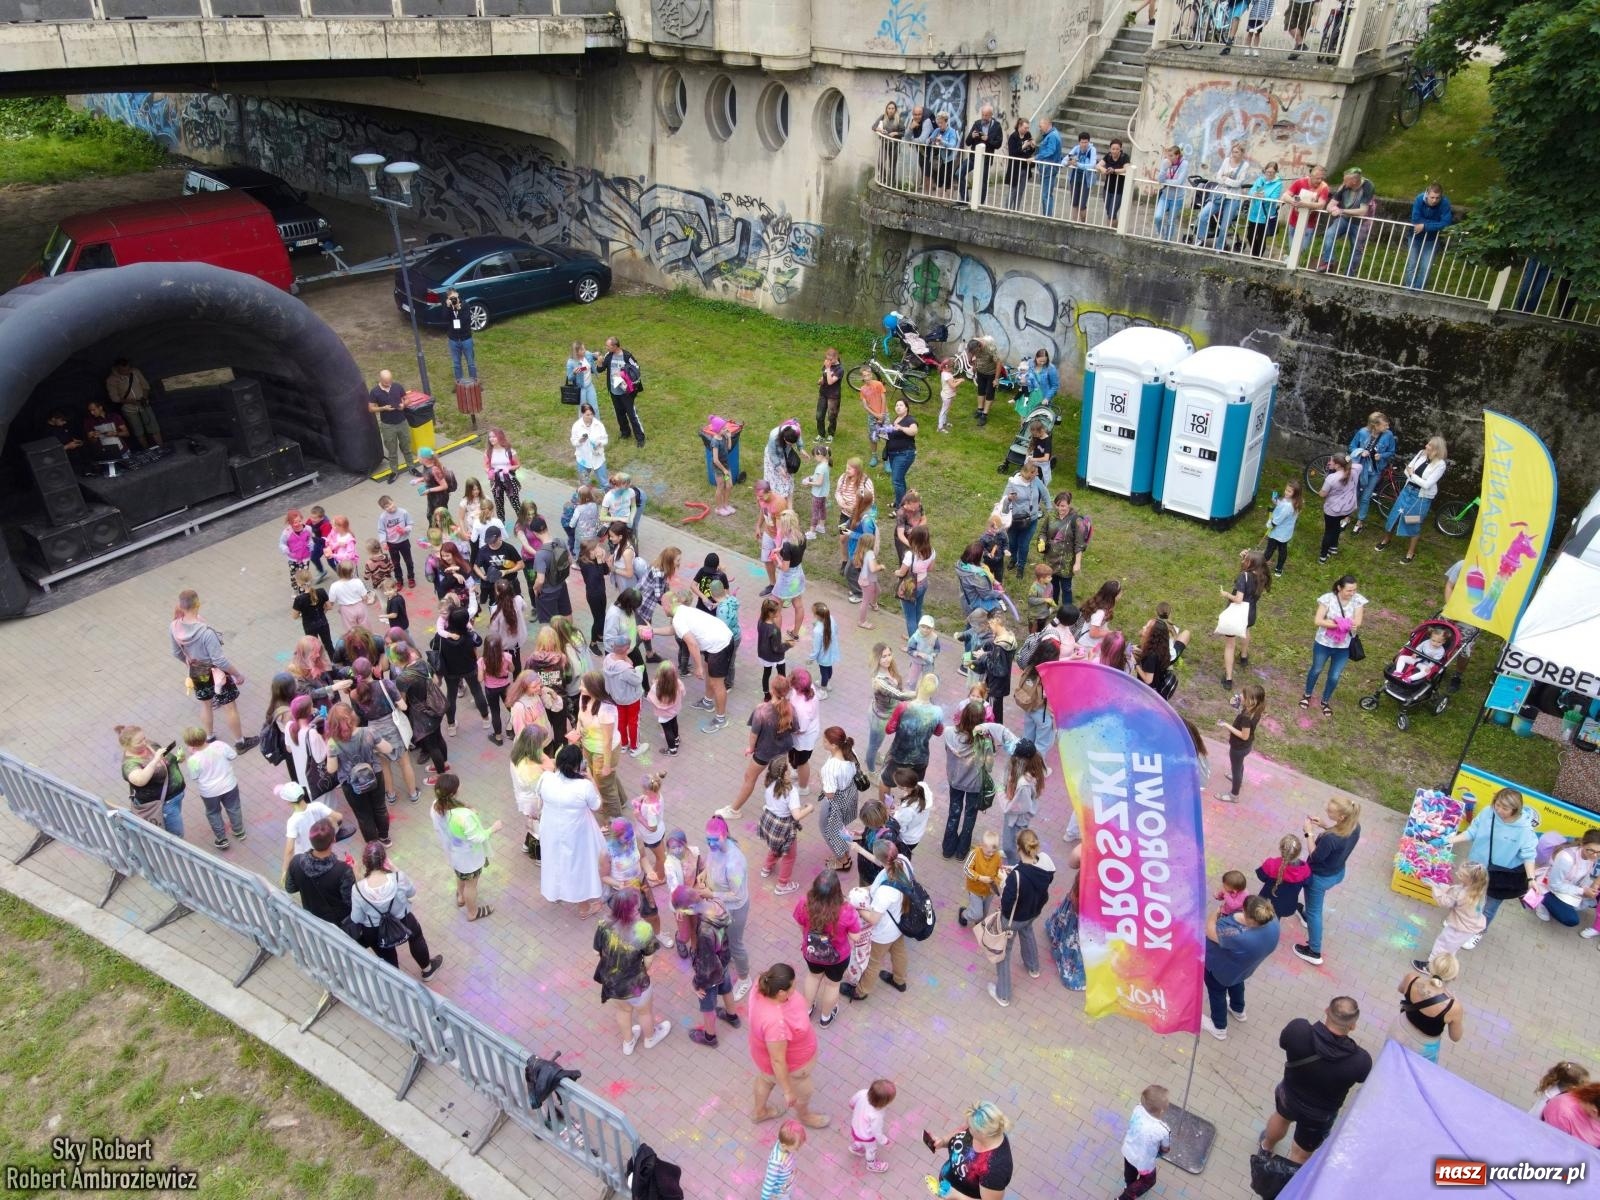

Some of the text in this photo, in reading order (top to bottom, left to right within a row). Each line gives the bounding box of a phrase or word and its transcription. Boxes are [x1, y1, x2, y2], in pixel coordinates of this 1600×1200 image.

[1110, 392, 1127, 406] TOI
[1109, 402, 1125, 414] TOI
[1191, 412, 1210, 426] TOI
[1190, 422, 1207, 435] TOI
[1504, 651, 1600, 697] SORBE
